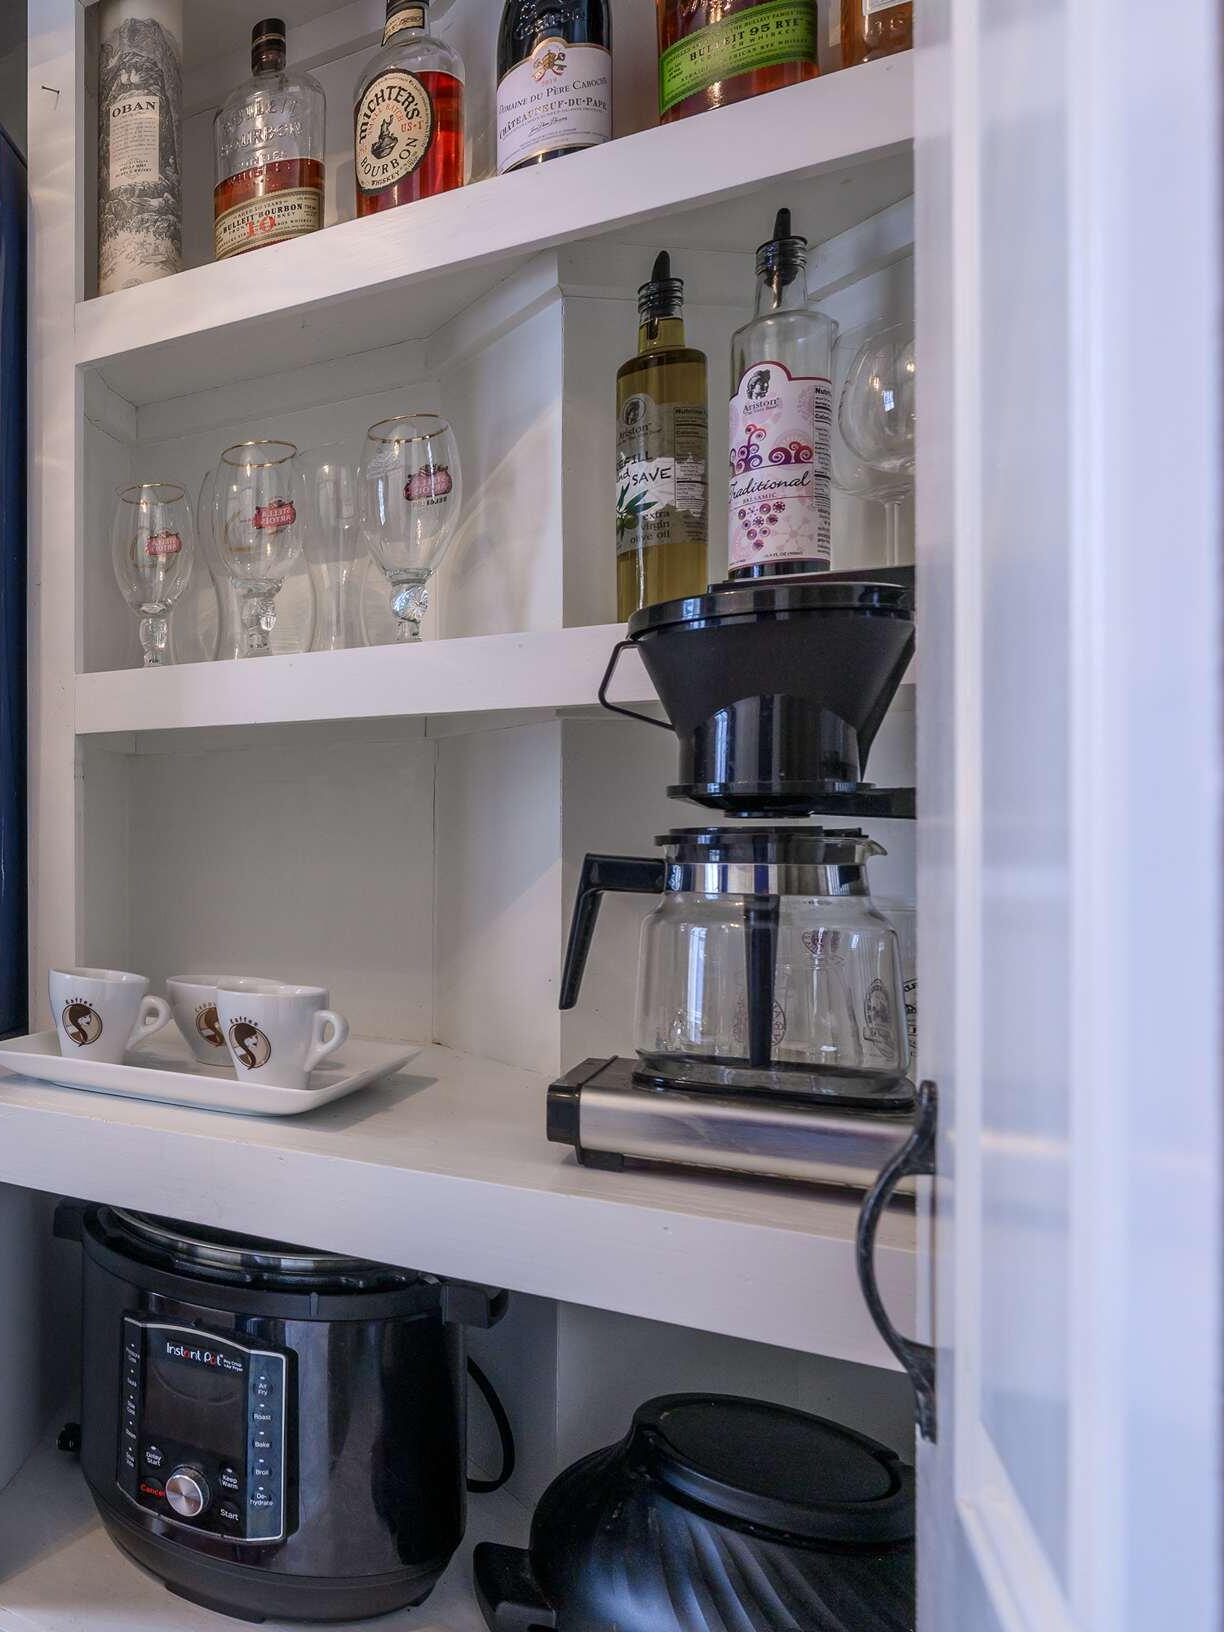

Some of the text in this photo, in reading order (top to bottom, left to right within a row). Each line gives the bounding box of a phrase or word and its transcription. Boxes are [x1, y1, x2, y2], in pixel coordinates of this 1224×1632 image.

[750, 22, 770, 36] 95
[776, 18, 800, 29] RYE
[112, 101, 156, 118] OBAN
[499, 98, 528, 114] DOMAINE
[530, 92, 544, 103] DU
[361, 137, 418, 177] BOURBON
[222, 203, 303, 234] BULLEIT BOURBON
[743, 399, 777, 412] Ariston
[632, 467, 672, 486] SAVE
[729, 470, 811, 499] Traditional
[166, 1342, 222, 1366] Instant Pot
[146, 1451, 162, 1461] Delay
[147, 1457, 161, 1466] Start
[222, 1474, 238, 1484] Keep
[222, 1480, 239, 1490] Warm
[220, 1508, 239, 1521] Start
